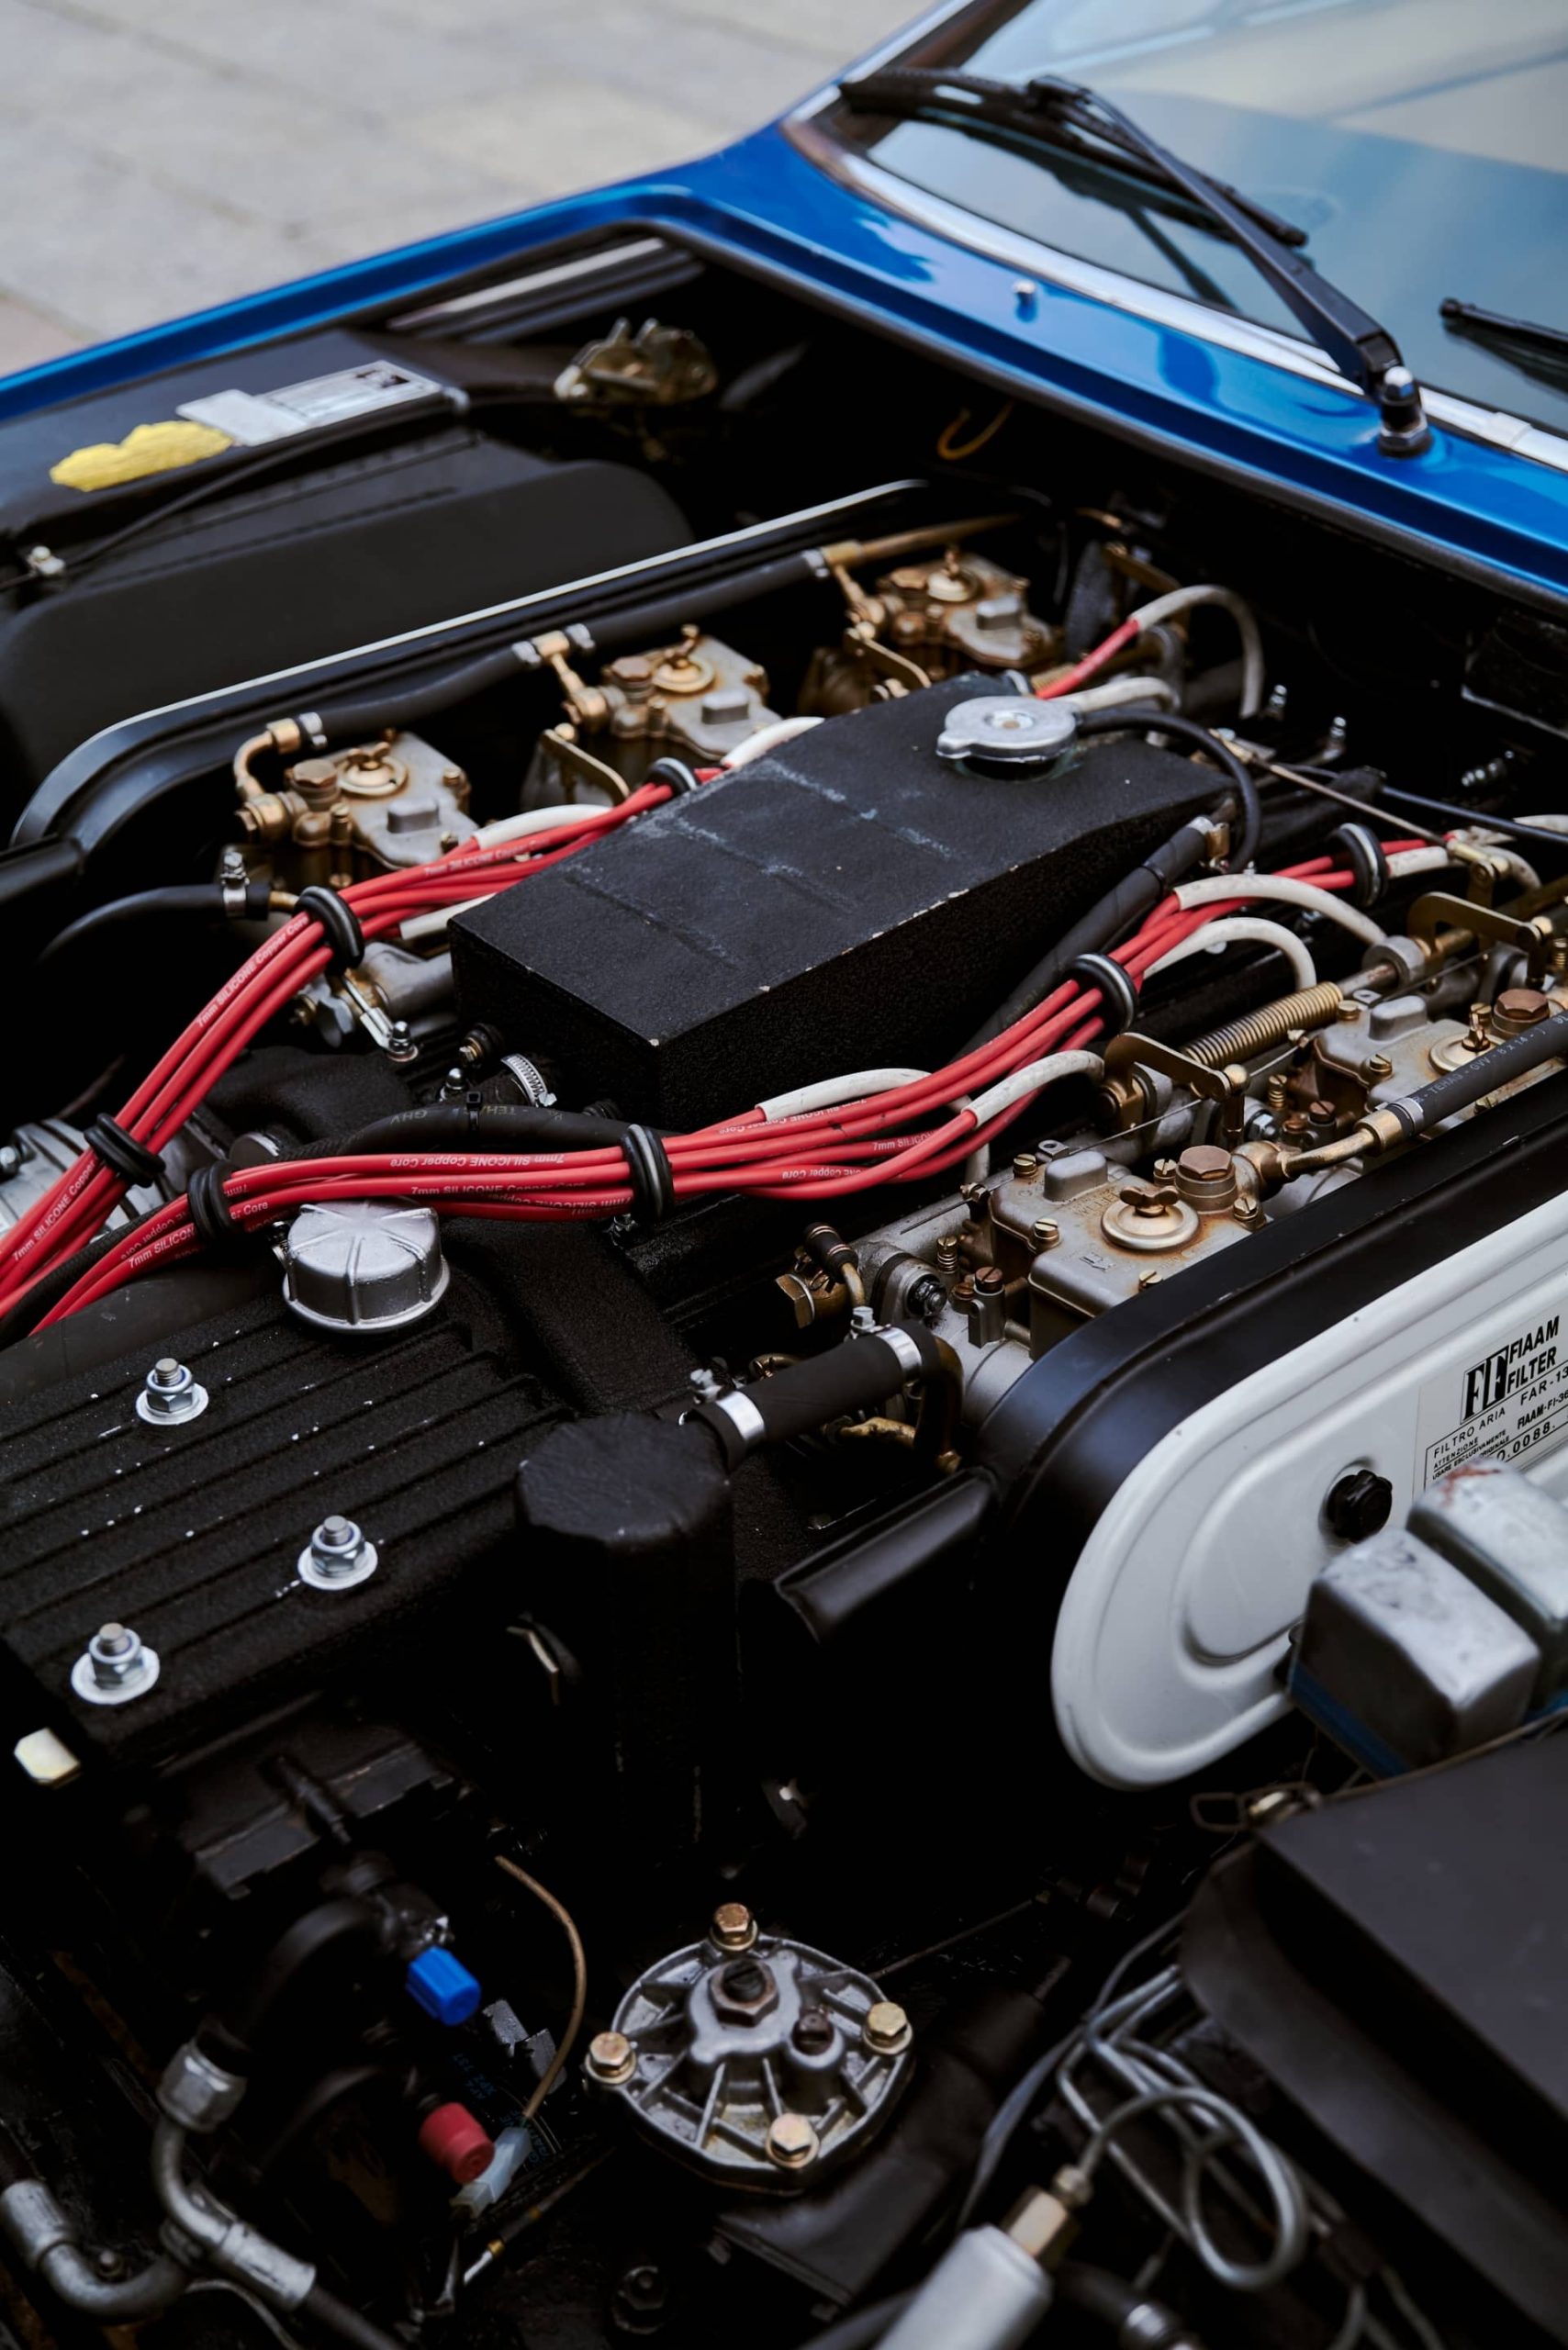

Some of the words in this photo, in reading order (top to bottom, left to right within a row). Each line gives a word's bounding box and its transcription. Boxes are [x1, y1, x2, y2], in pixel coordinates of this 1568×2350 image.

[197, 1003, 218, 1027] 7mm
[216, 962, 258, 1005] SILICONE
[256, 932, 286, 965] Copper
[286, 915, 309, 936] Core
[873, 1138, 897, 1151] 7mm
[389, 1158, 420, 1169] Core
[420, 1156, 467, 1168] Copper
[469, 1155, 532, 1168] SILICONE
[534, 1153, 566, 1164] 7mm
[781, 1169, 807, 1181] Core
[410, 1185, 441, 1195] 7mm
[13, 1239, 36, 1261] 7mm
[33, 1193, 73, 1241] SILICONE
[68, 1159, 96, 1196] Copper
[242, 1201, 269, 1215] Core
[129, 1249, 153, 1270] 7mm
[1509, 1315, 1560, 1365] FIAAM
[1506, 1346, 1558, 1394] FILTER
[1433, 1426, 1475, 1459] FILTRO
[1478, 1406, 1506, 1431] ARIA
[1433, 1436, 1479, 1470] ATTENZIONE
